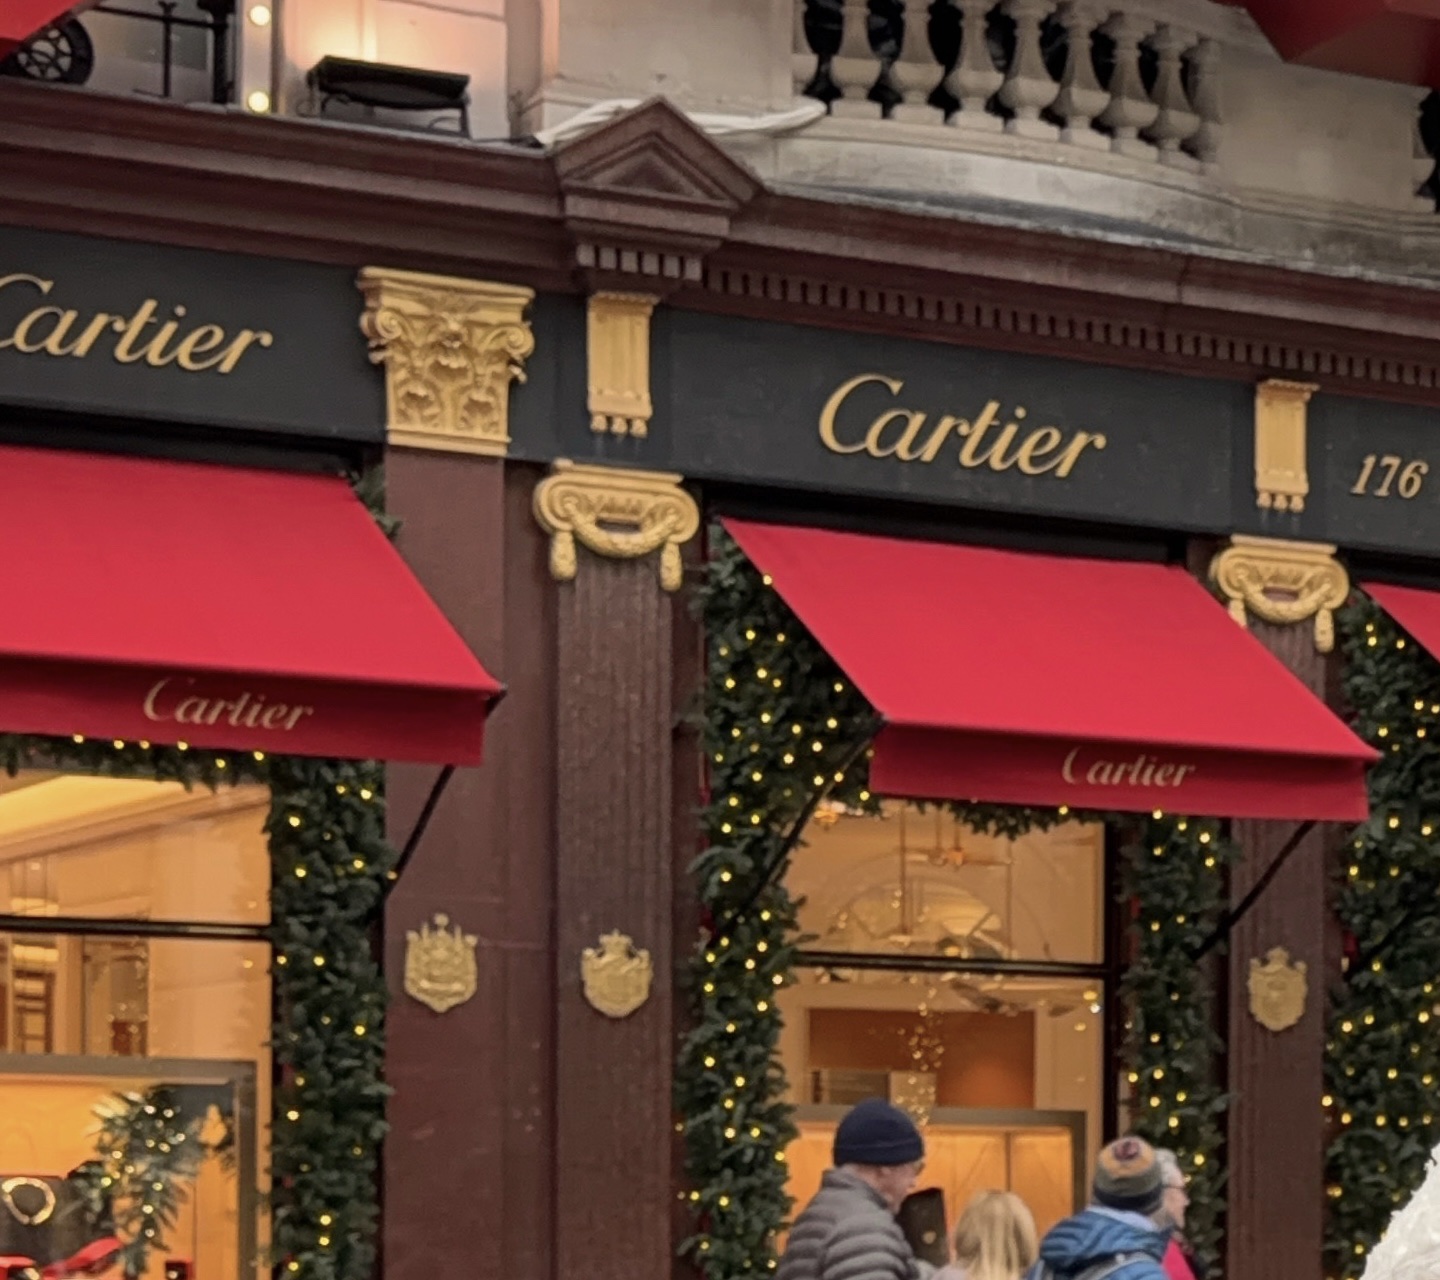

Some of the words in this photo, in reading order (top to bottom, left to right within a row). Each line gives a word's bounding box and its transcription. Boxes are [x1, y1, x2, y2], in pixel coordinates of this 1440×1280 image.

[0, 272, 273, 375] Cartier
[818, 373, 1107, 479] Cartier
[1351, 455, 1428, 500] 176
[143, 677, 313, 732] Cartier
[1062, 747, 1196, 789] Cartier
